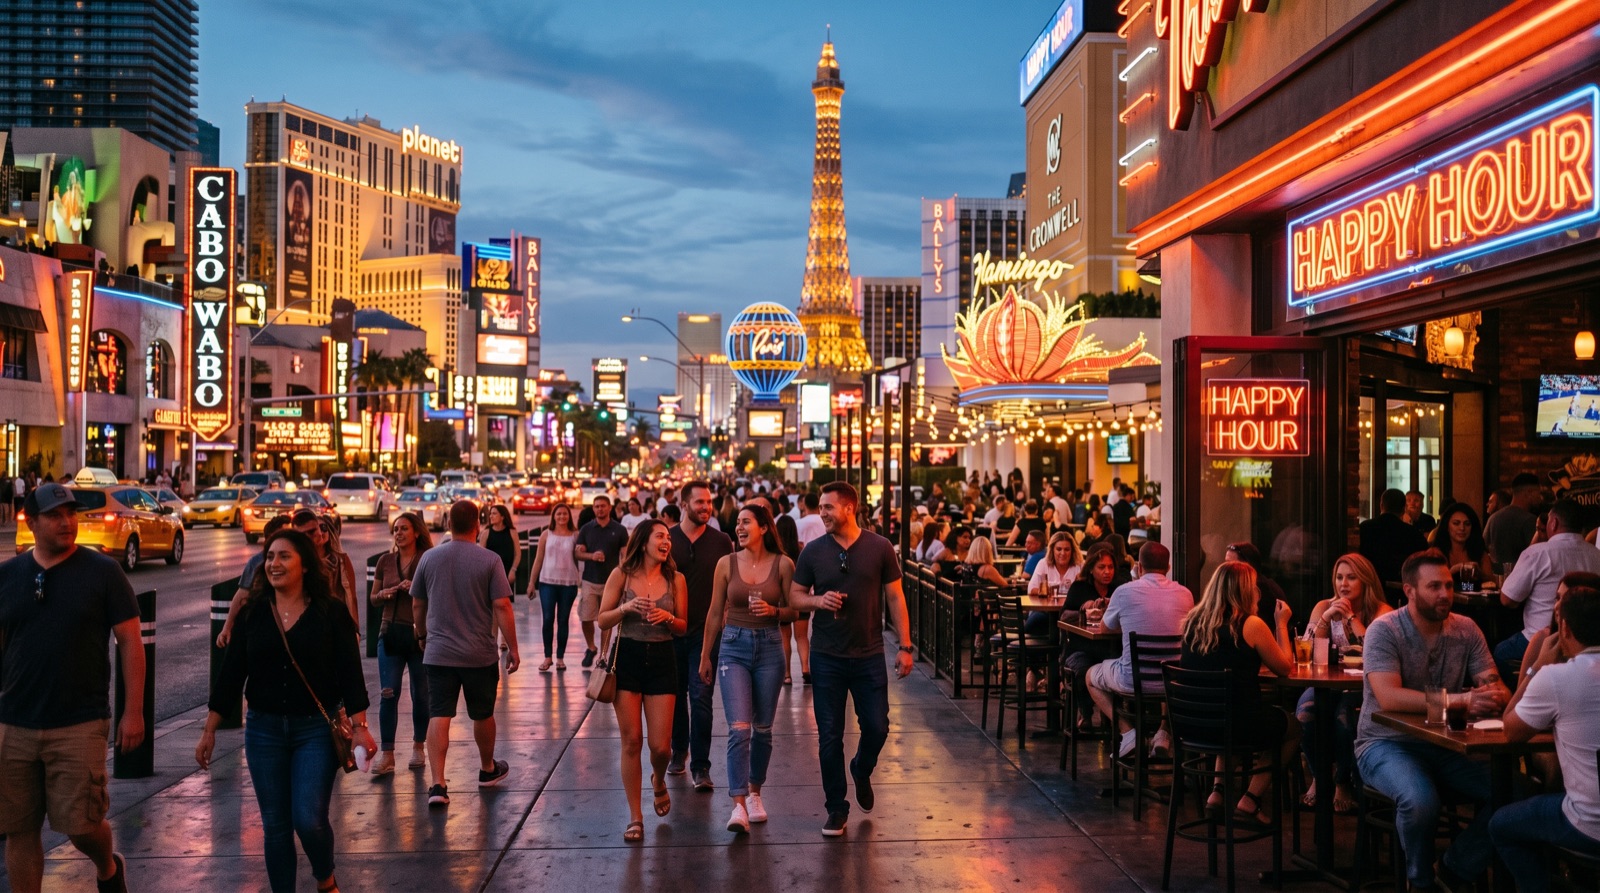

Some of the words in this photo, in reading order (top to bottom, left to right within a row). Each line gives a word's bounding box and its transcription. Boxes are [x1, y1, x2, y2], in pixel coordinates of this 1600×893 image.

[1026, 33, 1051, 86] HAPPY
[1051, 5, 1074, 54] HOUR
[402, 124, 461, 164] planet
[1047, 185, 1062, 210] THE
[1293, 183, 1417, 293] HAPPY
[1429, 113, 1593, 250] HOUR
[195, 175, 226, 284] CABO
[932, 203, 944, 293] BALLYS
[1029, 198, 1082, 253] CROMWELL
[526, 240, 539, 334] BALLYS
[972, 249, 1075, 298] Flamingo
[192, 301, 228, 408] WABO
[751, 328, 785, 363] Paris
[1211, 385, 1305, 416] HAPPY
[1218, 420, 1299, 451] HOUR
